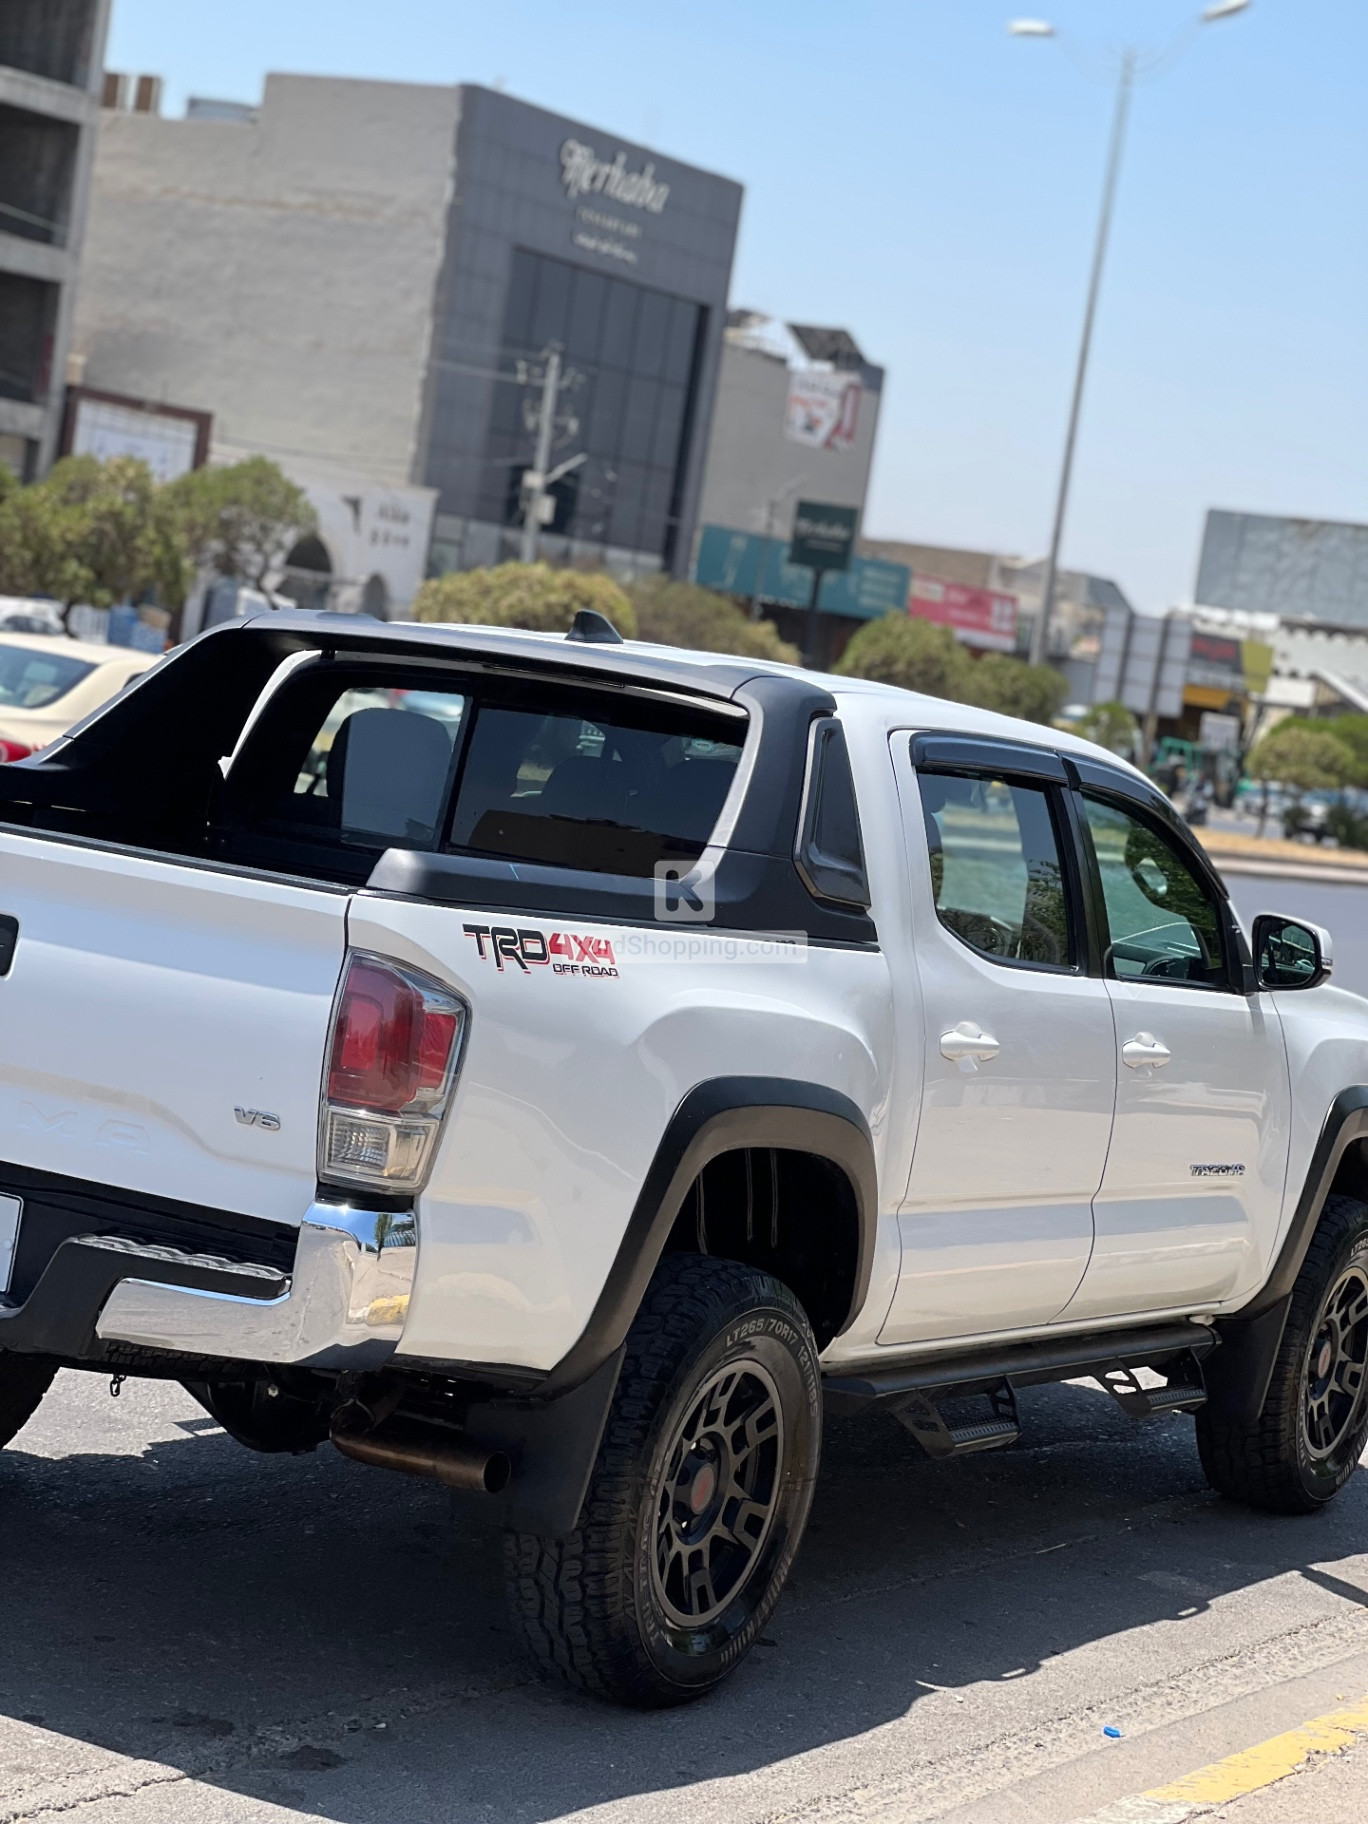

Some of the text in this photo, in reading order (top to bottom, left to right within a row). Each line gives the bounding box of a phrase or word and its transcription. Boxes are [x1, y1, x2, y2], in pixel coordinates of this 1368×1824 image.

[462, 923, 551, 975] TRD
[552, 963, 620, 979] OFF ROAD
[233, 1105, 281, 1132] V6
[726, 1317, 799, 1347] LT265/70R17
